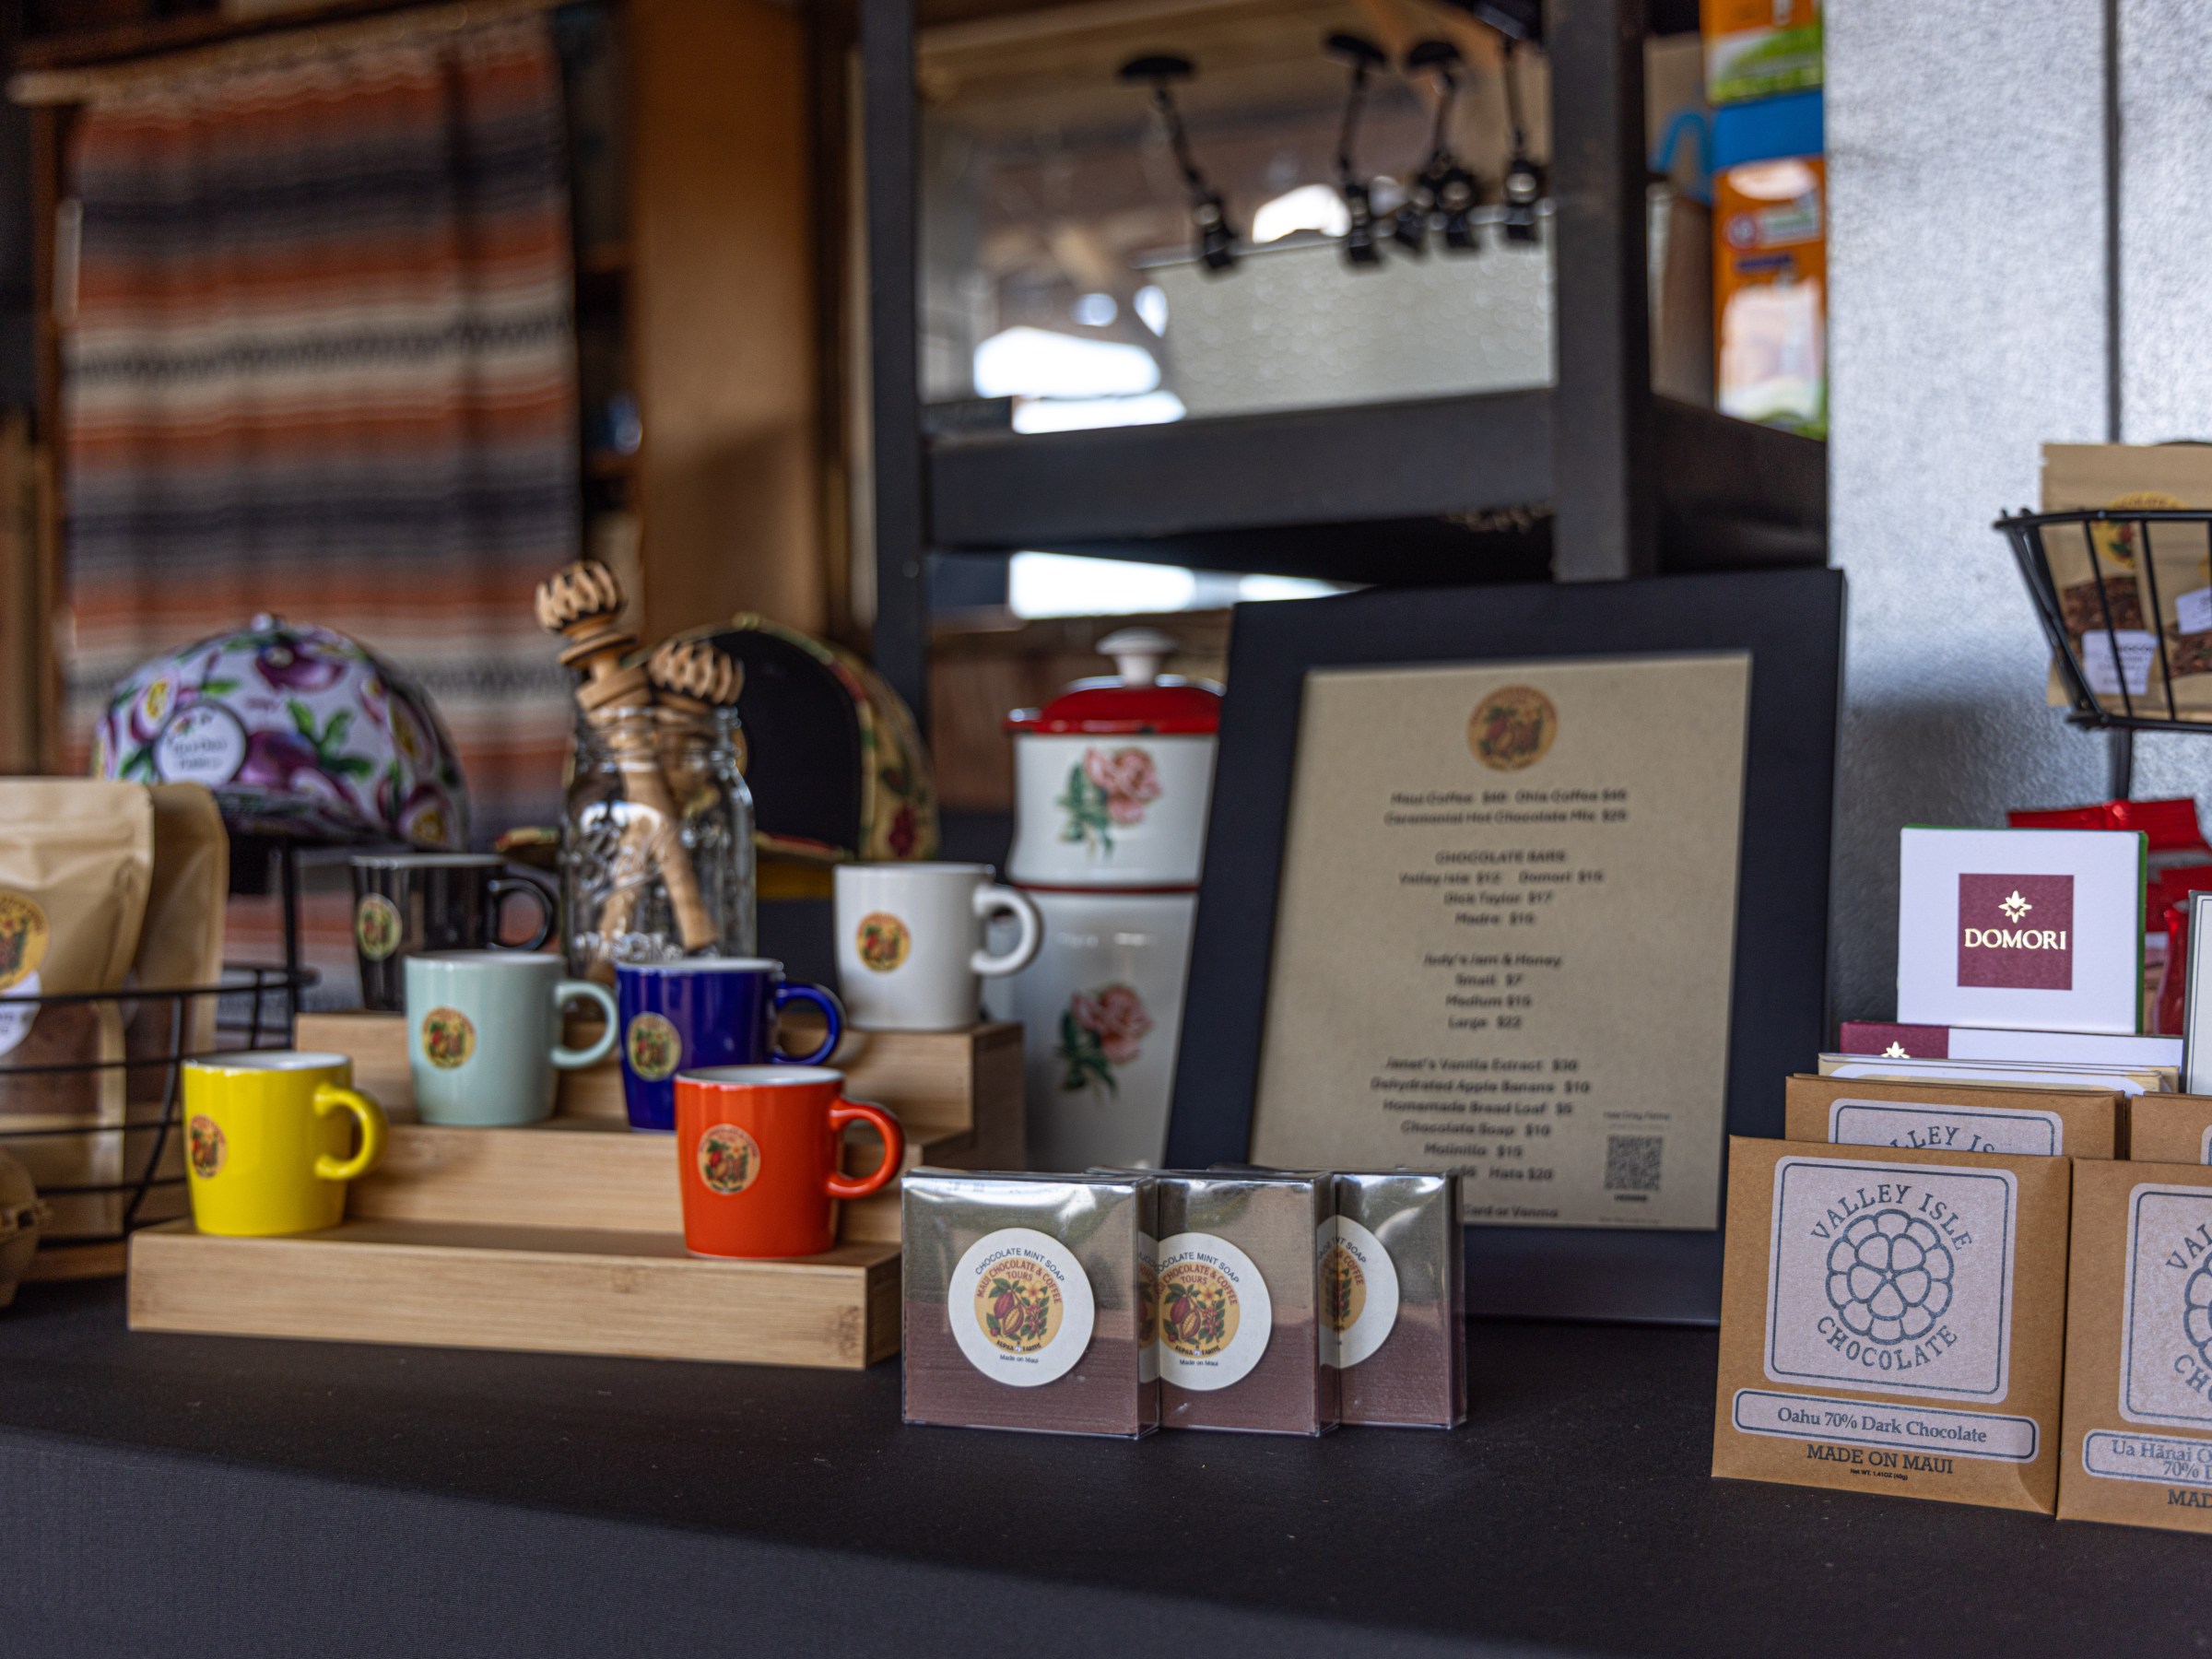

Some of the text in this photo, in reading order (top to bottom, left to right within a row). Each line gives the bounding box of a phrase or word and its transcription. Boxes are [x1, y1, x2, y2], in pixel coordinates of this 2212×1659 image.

[1426, 790, 1473, 805] Coffee
[1549, 788, 1597, 803] Coffee
[1493, 809, 1567, 825] Chocolate
[1435, 848, 1566, 865] CHOCOLATE BARS
[1399, 870, 1440, 886] Valley
[1477, 891, 1522, 906] Taylor
[1964, 927, 2067, 951] DOMORI
[1513, 953, 1562, 968] Honey
[1454, 972, 1496, 986] Small
[1444, 994, 1502, 1008] Medium
[1447, 1015, 1488, 1030] Large
[1439, 1056, 1488, 1071] Vanilla
[1490, 1057, 1543, 1071] Extract
[1370, 1077, 1453, 1092] Dehydrated
[1455, 1077, 1498, 1094] Apple
[1382, 1099, 1466, 1114] Homemade
[1468, 1100, 1512, 1114] Bread
[1513, 1100, 1547, 1116] Loaf
[1400, 1120, 1475, 1135] Chocolate
[1477, 1121, 1515, 1137] Soap
[1511, 1206, 1559, 1218] Venmo
[1810, 1183, 1974, 1252] VALLEY ISLE
[1346, 1241, 1367, 1263] SOAP
[2165, 1223, 2212, 1274] VAL
[975, 1247, 1065, 1282] CHOCOLATE MINT SOAP
[1196, 1253, 1218, 1265] MINT
[1218, 1262, 1240, 1283] SOAP
[1343, 1255, 1364, 1286] COFFEE
[976, 1260, 1062, 1304] MAUI CHOCOLATE & COFFEE
[1006, 1270, 1033, 1282] TOURS
[1163, 1264, 1210, 1284] CHOCOLATE
[1210, 1270, 1217, 1278] &
[1217, 1276, 1239, 1305] COFFEE
[1181, 1274, 1207, 1286] TOURS
[1817, 1315, 1958, 1371] CHOCOLATE
[999, 1354, 1016, 1362] Made
[1025, 1356, 1040, 1364] Maui
[1777, 1406, 1987, 1443] Oahu 70% Dark Chocolate
[2112, 1439, 2136, 1456] Ua
[1806, 1443, 1953, 1475] MADE ON MAUI
[2162, 1460, 2200, 1478] 70%
[2167, 1488, 2212, 1509] MAD
